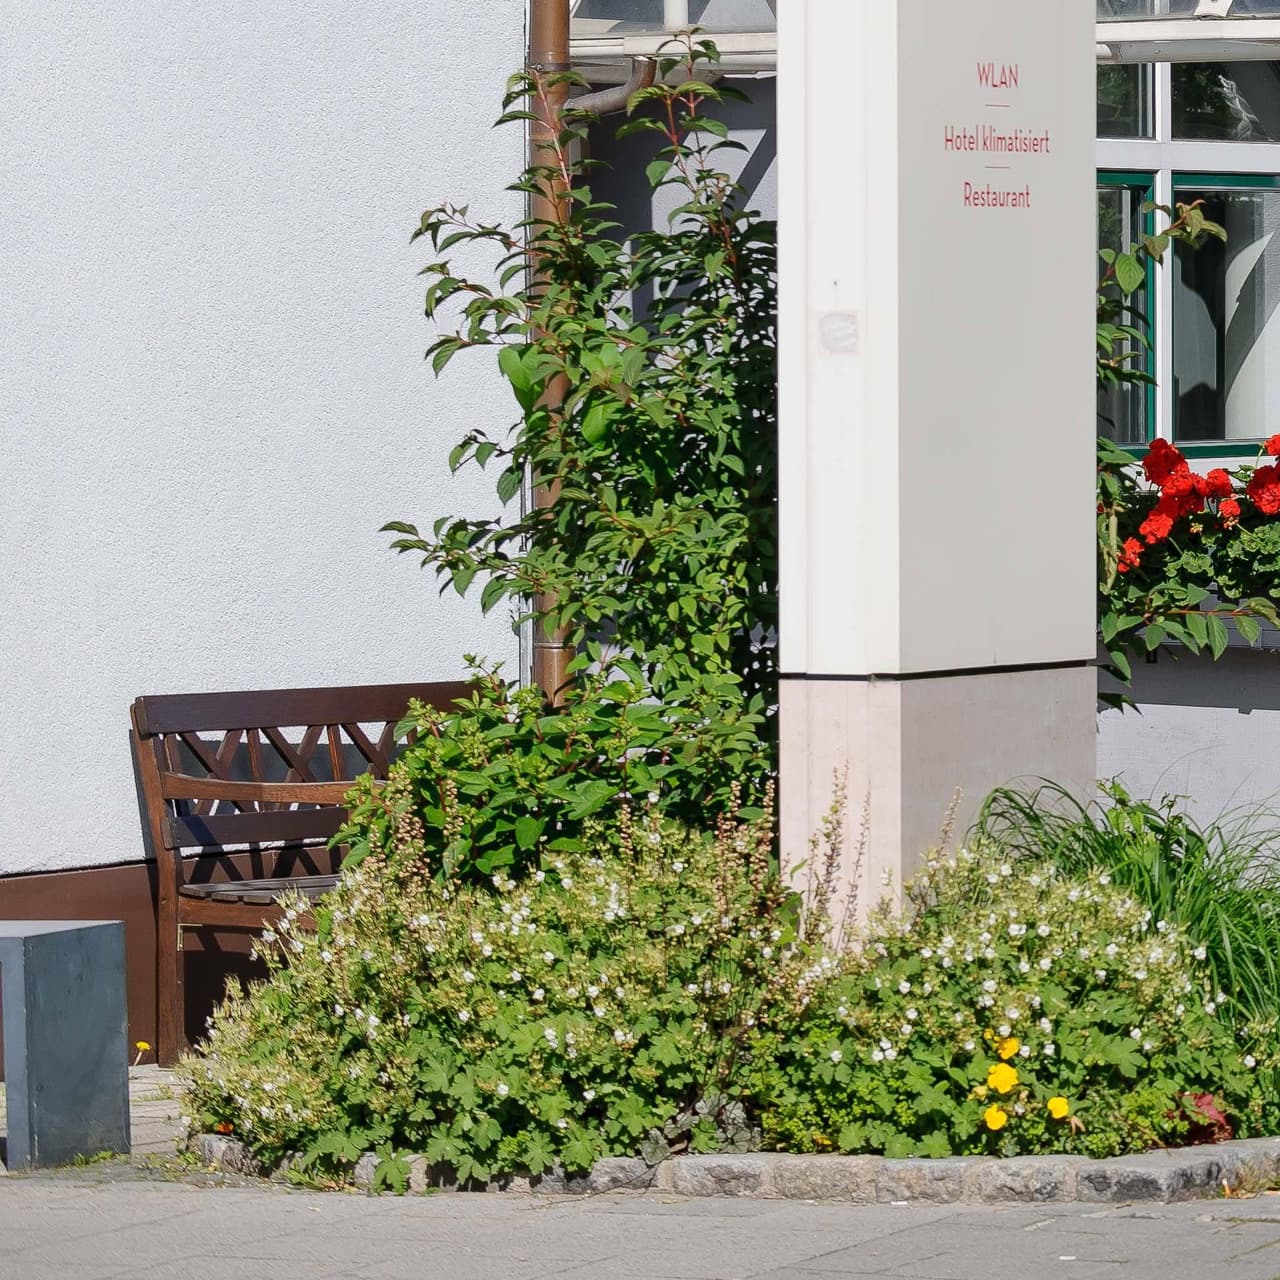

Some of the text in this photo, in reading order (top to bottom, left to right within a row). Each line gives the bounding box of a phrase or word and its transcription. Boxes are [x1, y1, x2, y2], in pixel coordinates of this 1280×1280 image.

[977, 62, 1018, 89] WLAN
[944, 125, 1050, 153] Hotel klimatisiert
[963, 182, 1030, 208] Restaurant
